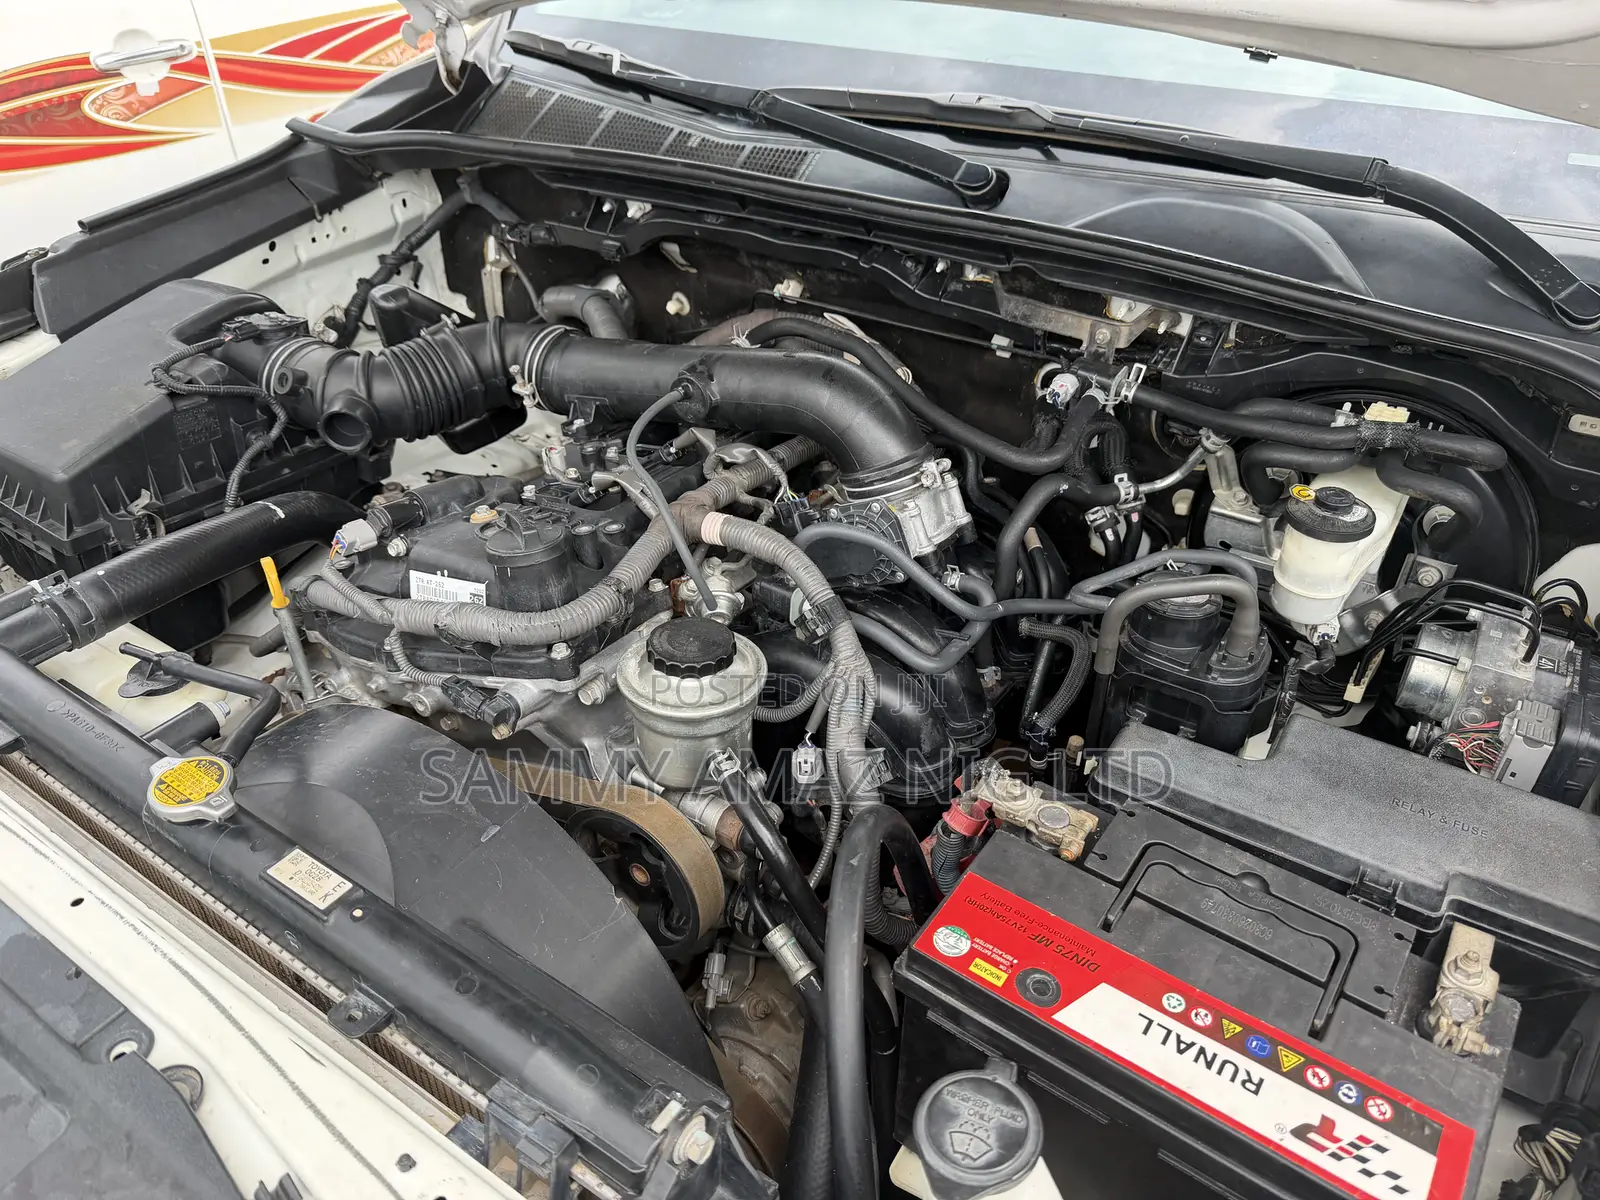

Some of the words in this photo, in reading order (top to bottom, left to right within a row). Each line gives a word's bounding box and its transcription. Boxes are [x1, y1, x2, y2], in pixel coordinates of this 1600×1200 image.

[469, 594, 484, 605] 262
[1391, 797, 1436, 819] RELAY
[1439, 815, 1448, 825] &
[1453, 819, 1489, 840] FUSE
[308, 861, 333, 880] TOYOTA
[980, 892, 1013, 914] Battery
[1014, 908, 1097, 958] Maintenance-Free
[1028, 932, 1052, 949] MF
[972, 942, 992, 956] BATTERY
[973, 937, 993, 950] BATTERY
[1052, 944, 1101, 974] DIN75
[972, 961, 1003, 982] INDICATOR
[1137, 1012, 1265, 1097] RUNALL
[967, 1107, 995, 1124] ONLY
